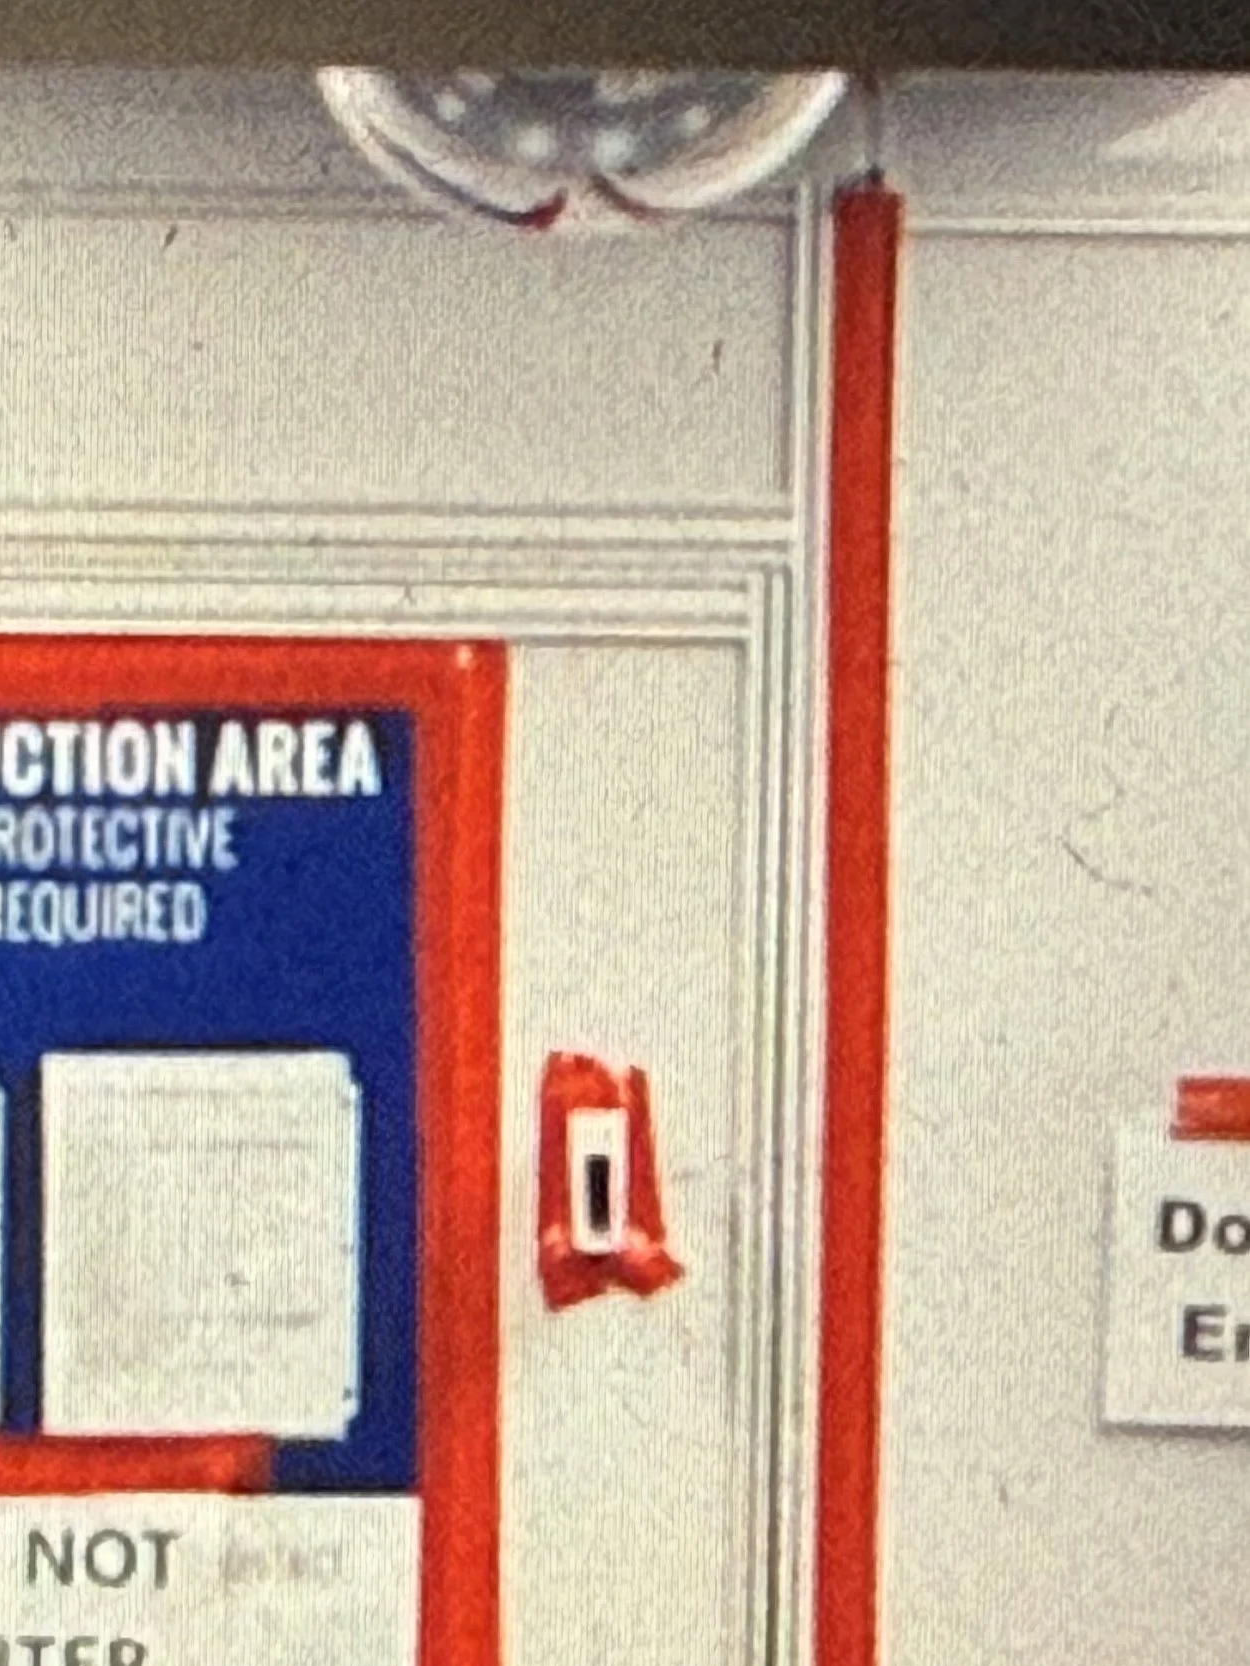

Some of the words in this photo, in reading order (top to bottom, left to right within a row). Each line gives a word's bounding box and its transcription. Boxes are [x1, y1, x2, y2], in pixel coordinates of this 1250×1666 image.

[208, 720, 382, 796] AREA
[1160, 1199, 1250, 1255] Do
[28, 1527, 184, 1589] NOT
